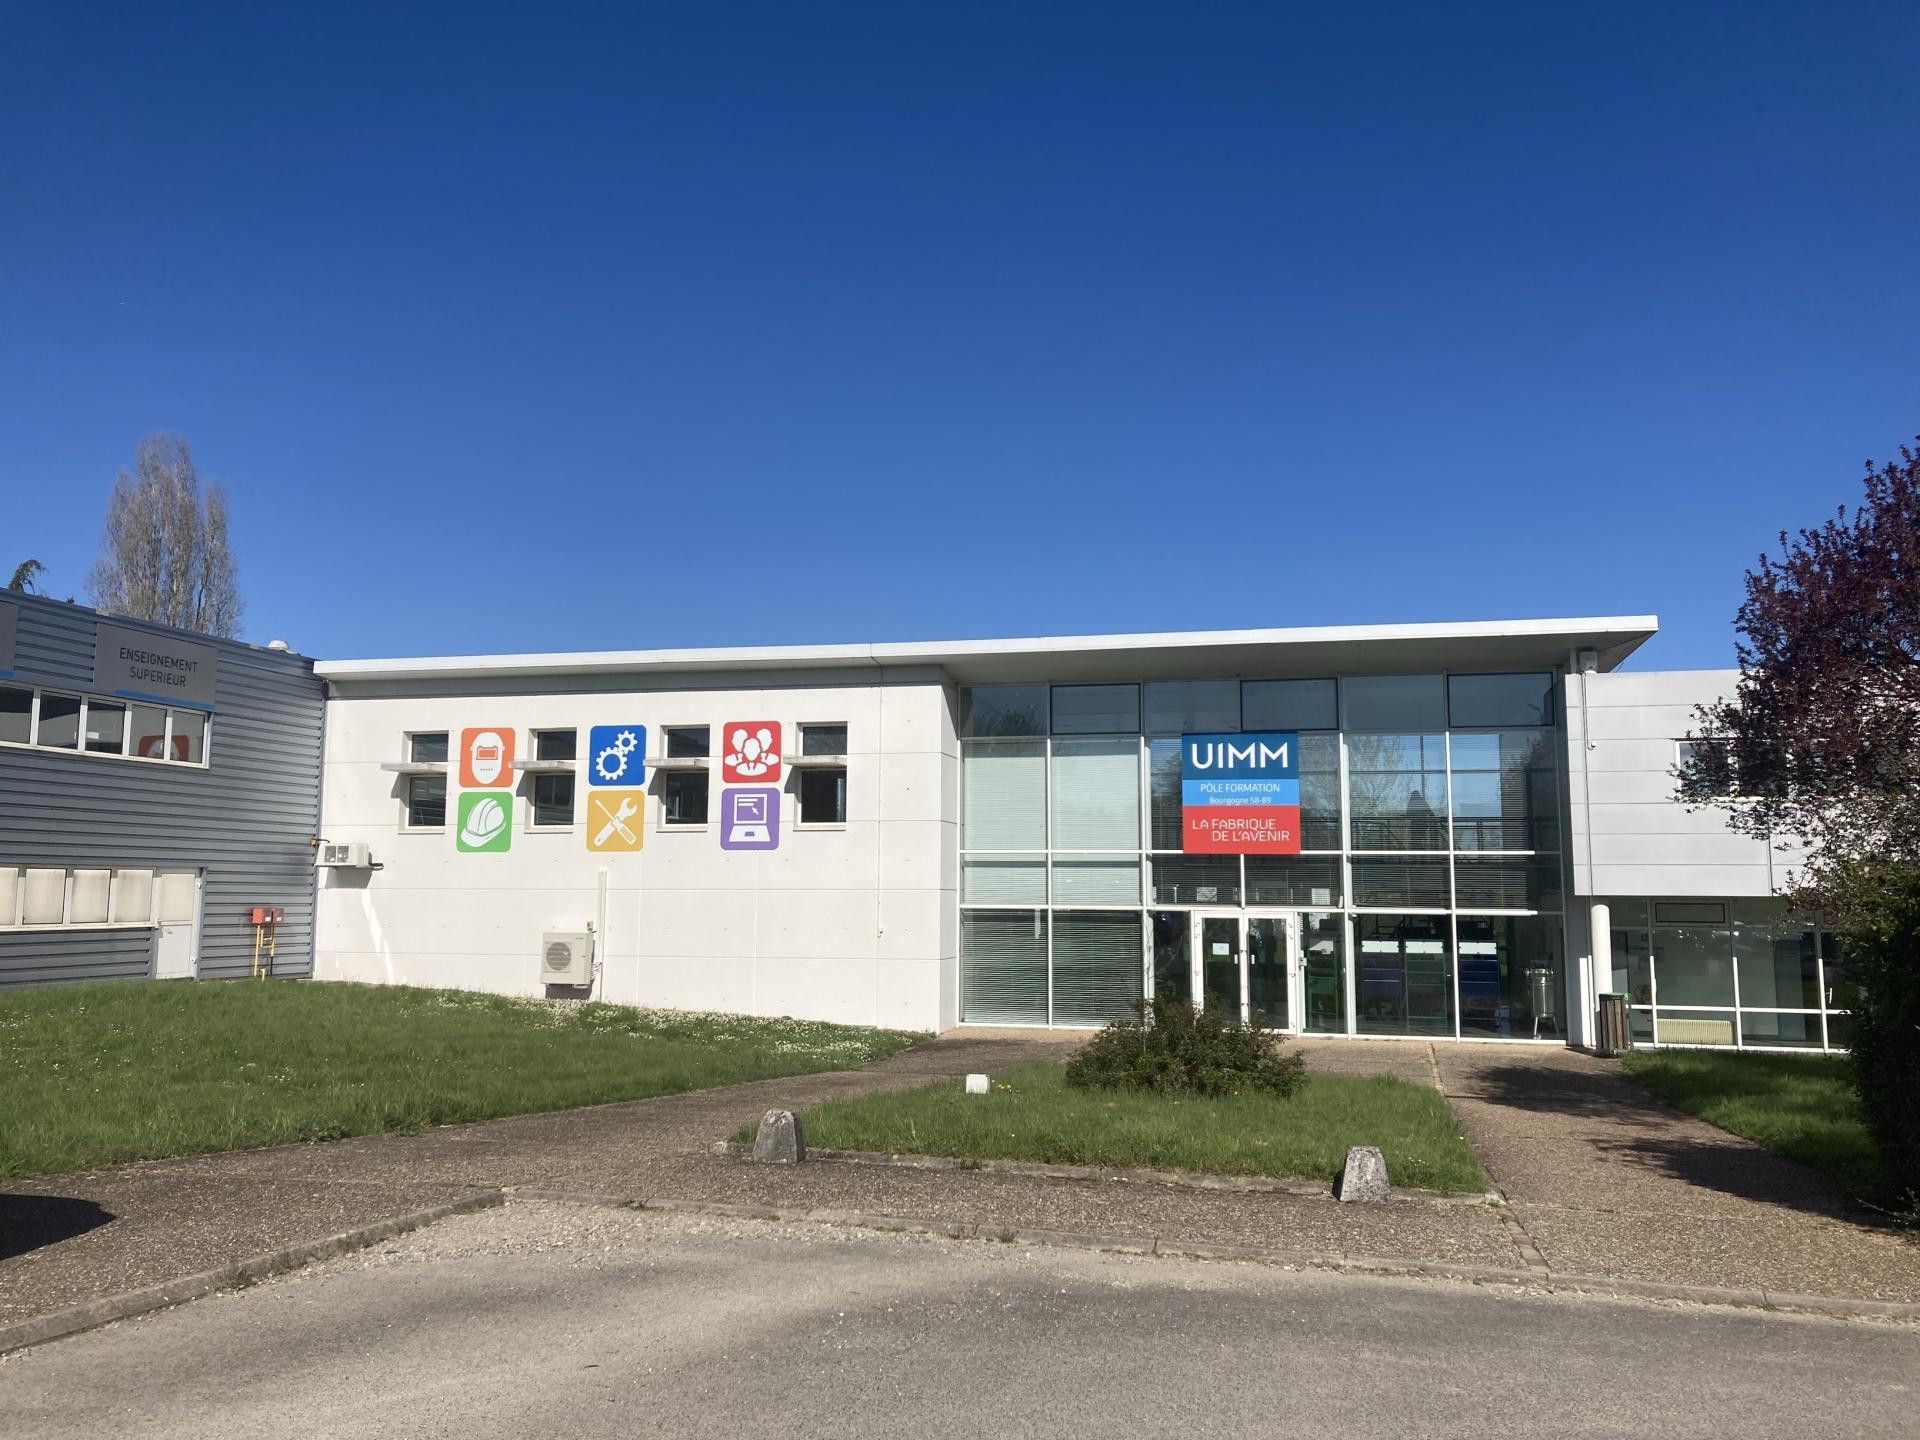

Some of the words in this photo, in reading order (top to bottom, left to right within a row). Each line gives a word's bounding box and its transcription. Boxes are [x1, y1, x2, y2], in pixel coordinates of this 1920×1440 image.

[119, 647, 198, 673] ENSEIGNEMENT
[129, 666, 187, 687] SUPERIEUR
[1191, 742, 1289, 769] UIMM
[1200, 782, 1224, 793] PÔLE
[1225, 783, 1281, 793] FORMATION
[1192, 819, 1209, 830] LA
[1212, 818, 1277, 831] FABRIQUE
[1212, 830, 1230, 842] DE
